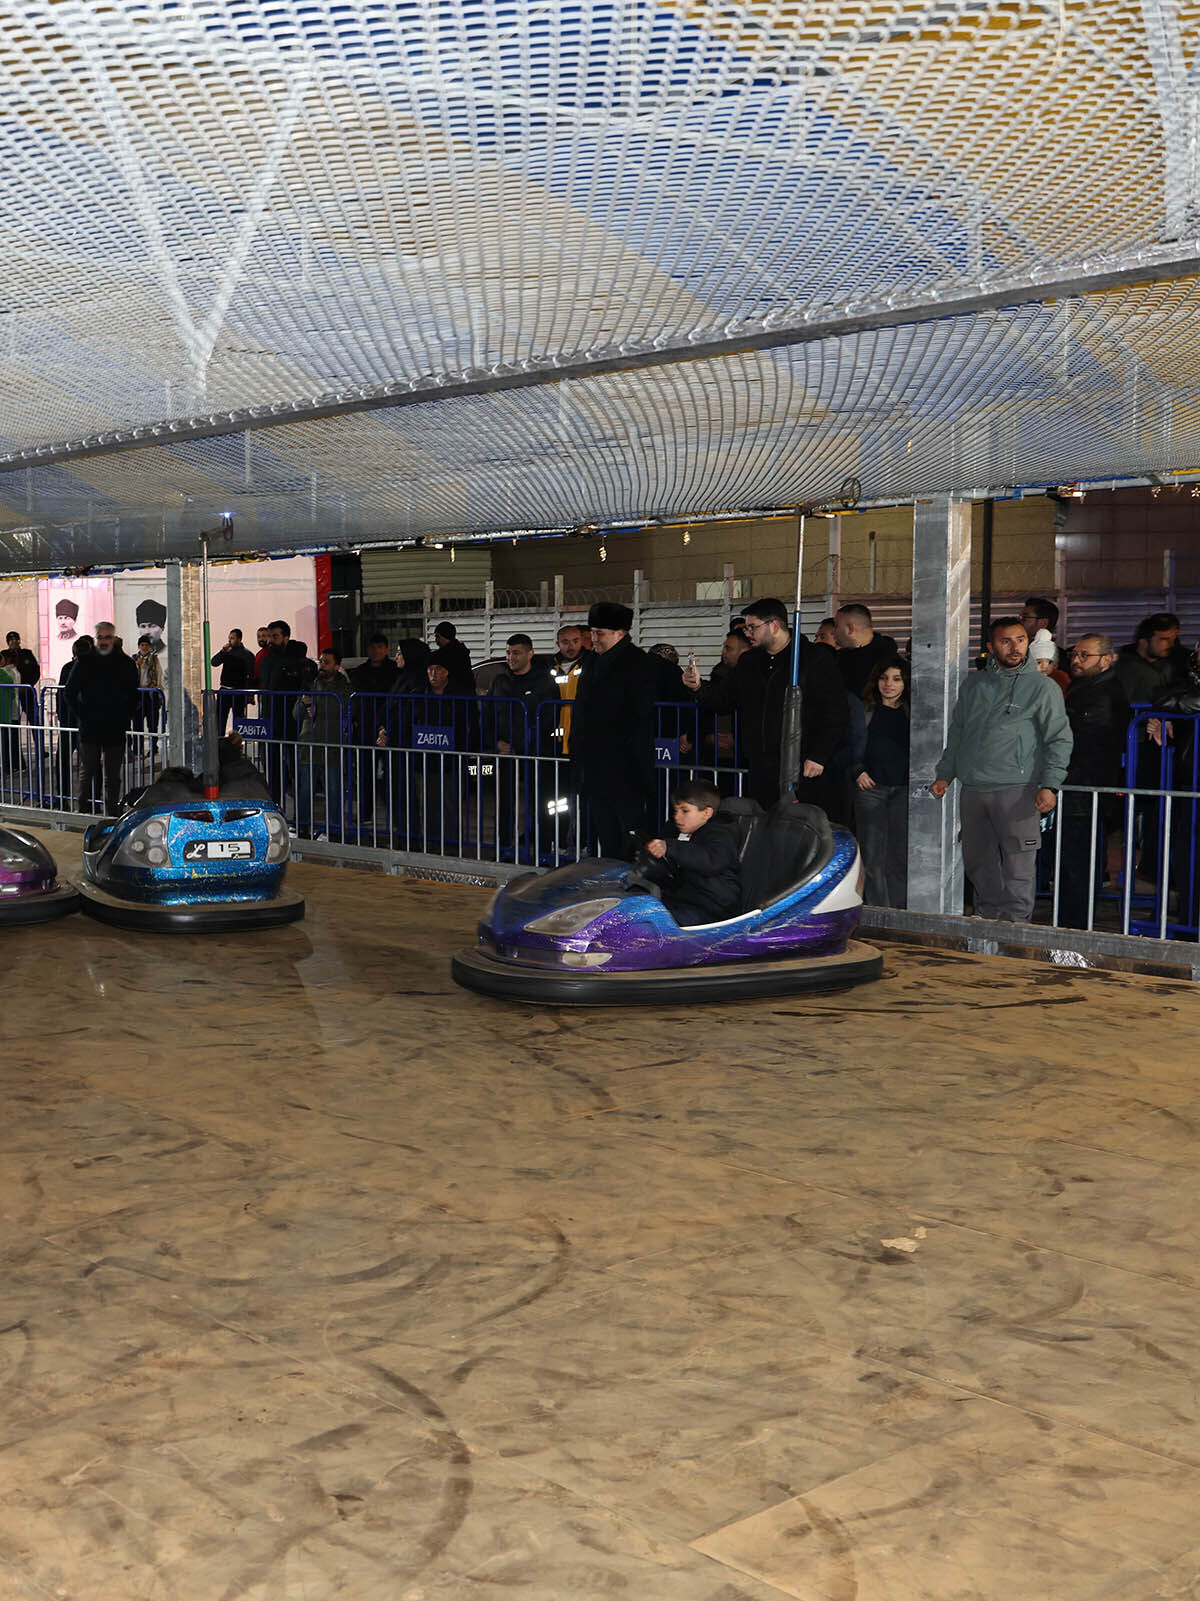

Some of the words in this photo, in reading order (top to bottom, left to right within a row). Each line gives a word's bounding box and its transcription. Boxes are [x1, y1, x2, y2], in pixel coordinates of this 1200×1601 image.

[237, 724, 267, 736] ZABITA
[417, 733, 449, 746] ZABITA
[218, 843, 240, 853] 15
